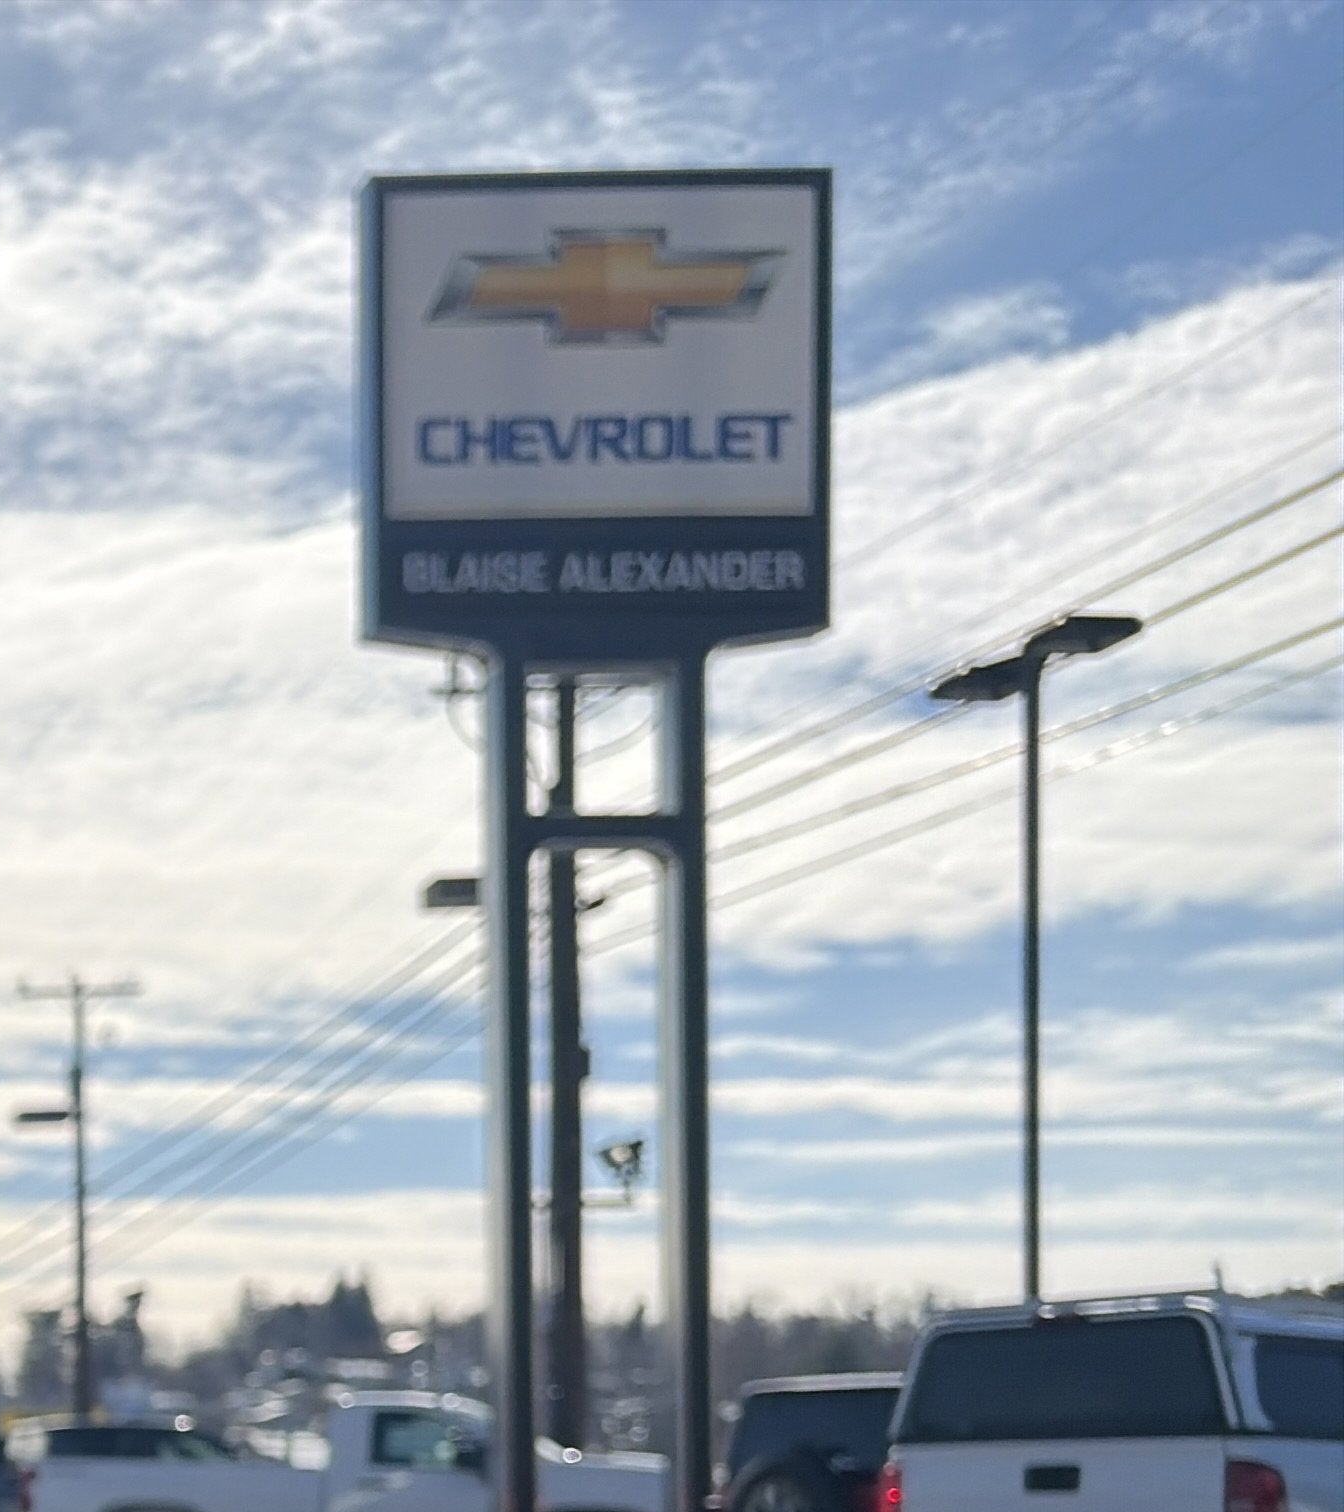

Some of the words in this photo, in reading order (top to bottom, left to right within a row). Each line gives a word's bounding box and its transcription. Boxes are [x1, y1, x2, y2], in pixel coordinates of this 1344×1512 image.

[418, 413, 792, 464] CHEVROLET
[402, 551, 548, 593] BLAISE
[559, 550, 806, 593] ALEXANDER
